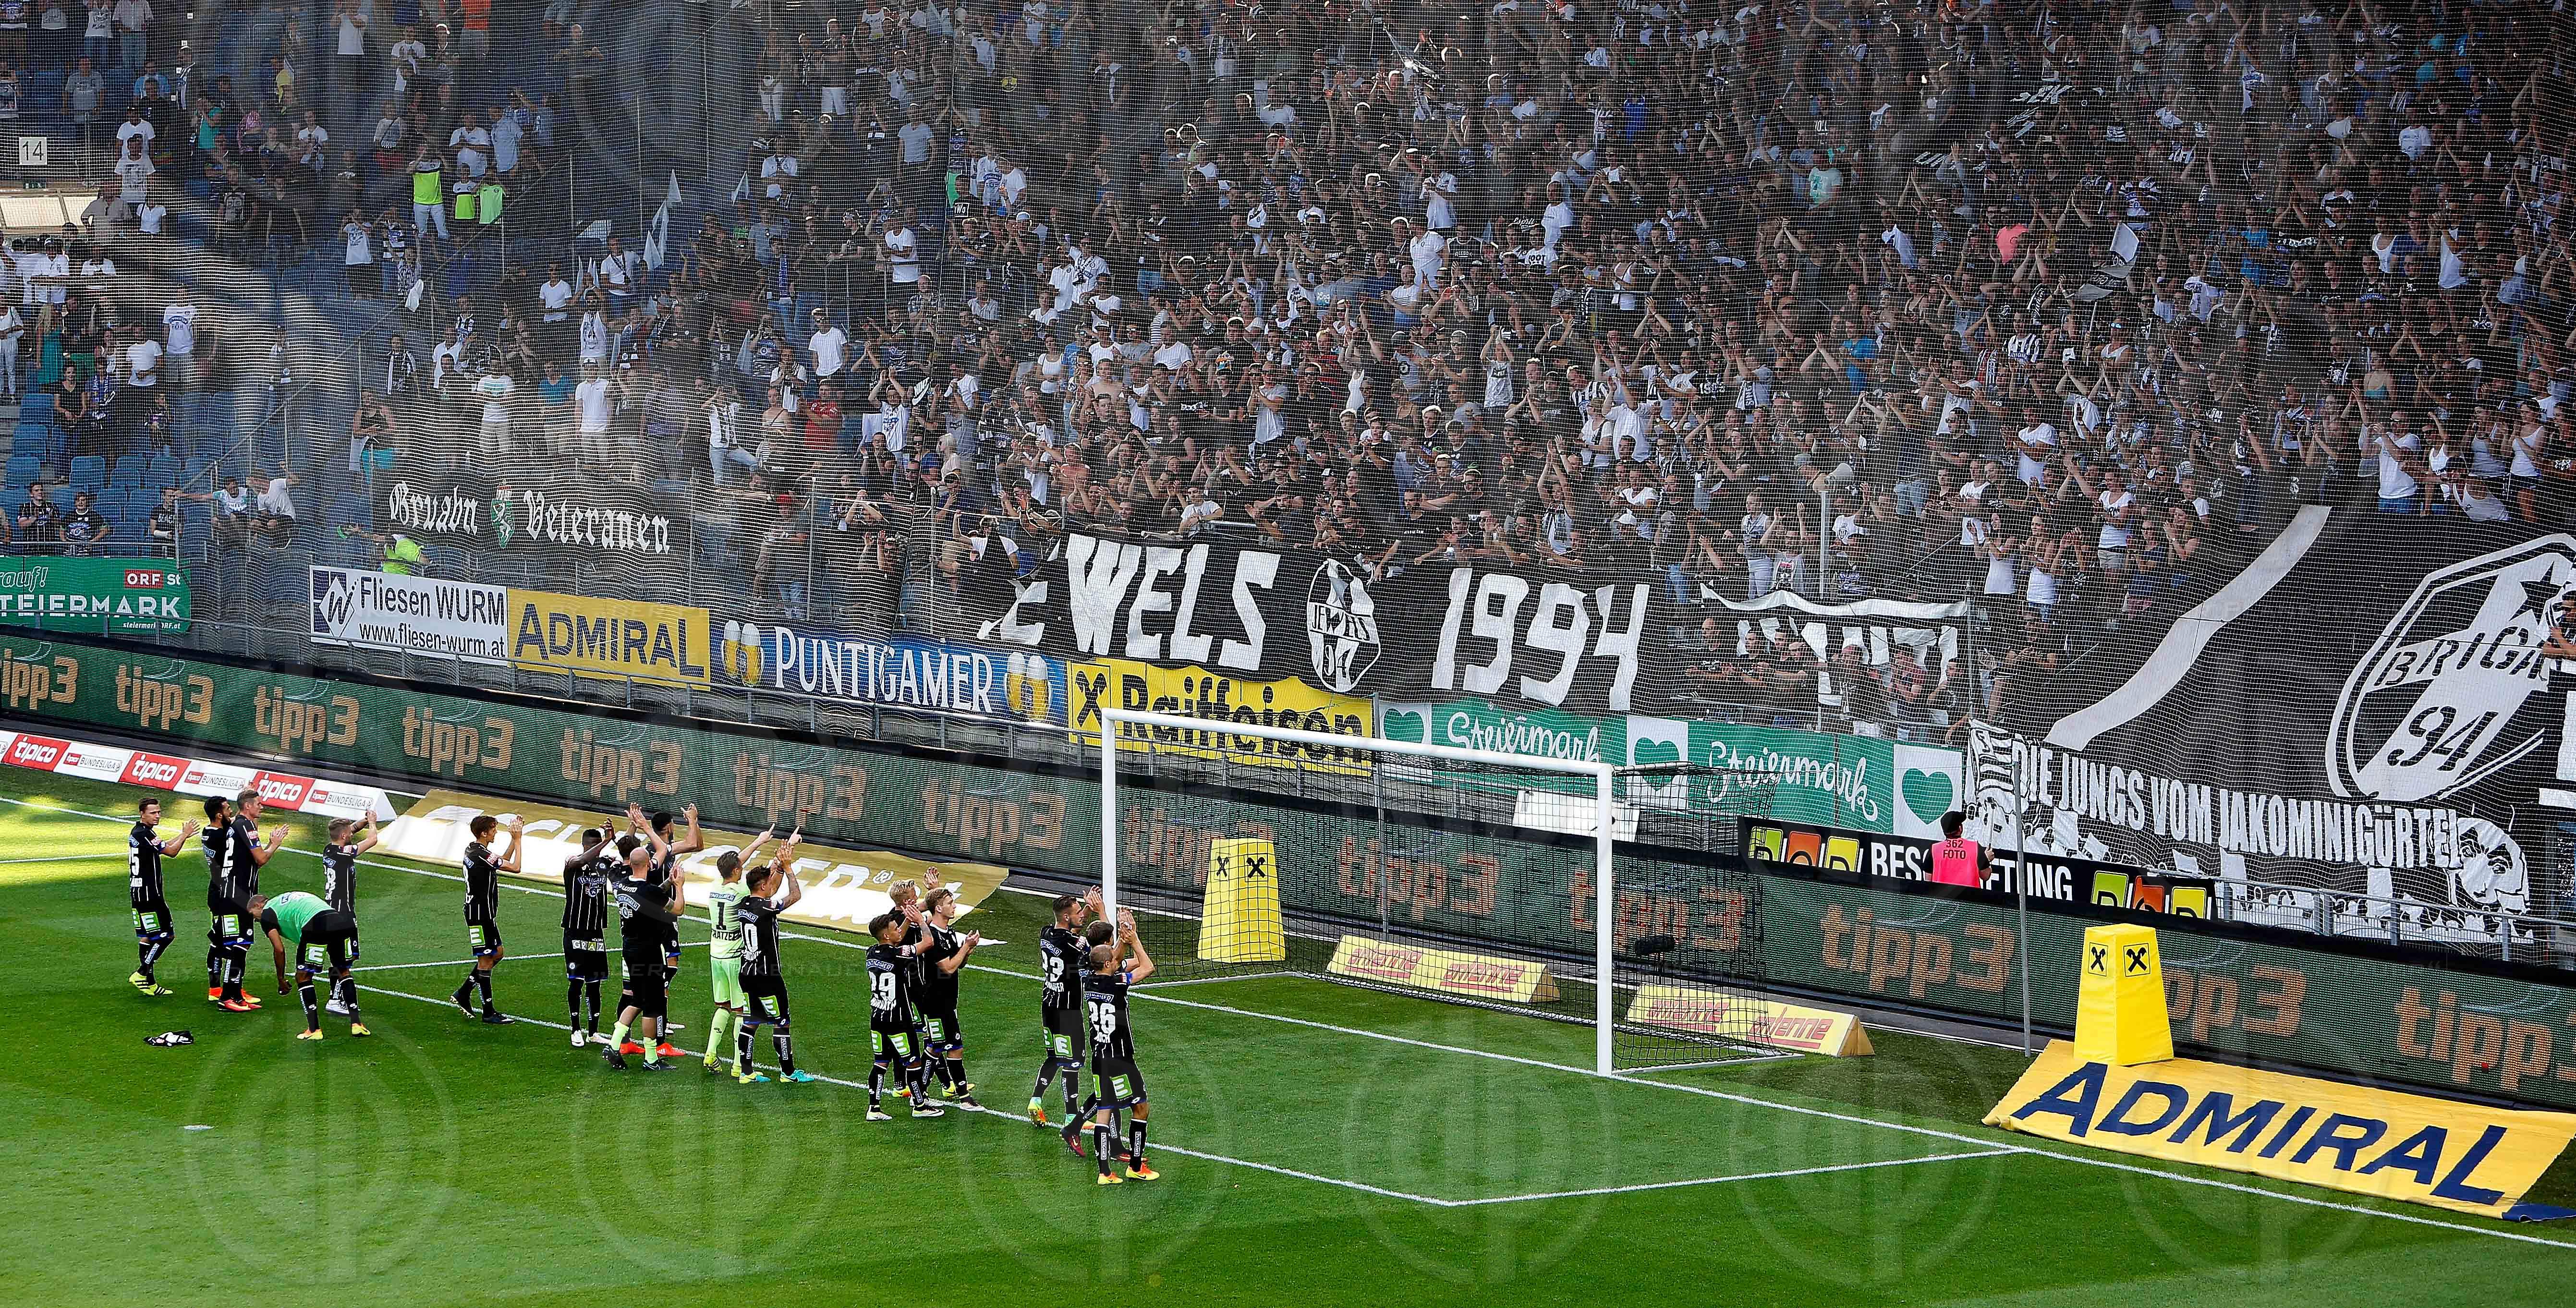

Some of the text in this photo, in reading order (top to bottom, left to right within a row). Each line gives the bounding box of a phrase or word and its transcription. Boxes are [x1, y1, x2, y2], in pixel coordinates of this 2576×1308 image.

[22, 141, 43, 161] 14
[524, 490, 670, 554] Veteranen
[127, 573, 161, 585] ORF
[359, 577, 505, 627] Fliesen WURM
[359, 623, 505, 658] www.fliesen-wurm.at
[514, 603, 705, 678] ADMIRAL
[1432, 567, 1650, 711] 1994
[116, 665, 215, 730] tipp3
[775, 626, 993, 713] PUNTIGAMER
[255, 685, 359, 753] tipp3
[401, 707, 513, 776] tipp3
[1123, 675, 1363, 764] Raiffeisen
[1447, 712, 1599, 763] Steiermark
[14, 736, 58, 763] tipico
[80, 755, 116, 769] BUNDESLIGA
[131, 754, 178, 782] tipico
[559, 726, 682, 801] tipp3
[202, 775, 237, 788] BUNDESLIGA
[257, 773, 302, 802] tipico
[327, 794, 366, 807] BUNDESLIGA
[735, 751, 865, 828] tipp3
[1706, 740, 1878, 822] Steiermark
[2011, 738, 2462, 869] DIE JUNGS VOM JAKOMINIGÜRTEL
[922, 773, 1066, 856] tipp3
[1943, 849, 1967, 859] FOTO
[1946, 839, 1964, 848] 362
[1338, 837, 1500, 922] tipp3
[716, 901, 727, 930] 1
[572, 940, 605, 952] GRAZ
[1820, 906, 2013, 998] tipp3
[1749, 1006, 1834, 1042] antenne
[2009, 1061, 2507, 1206] ADMIRAL
